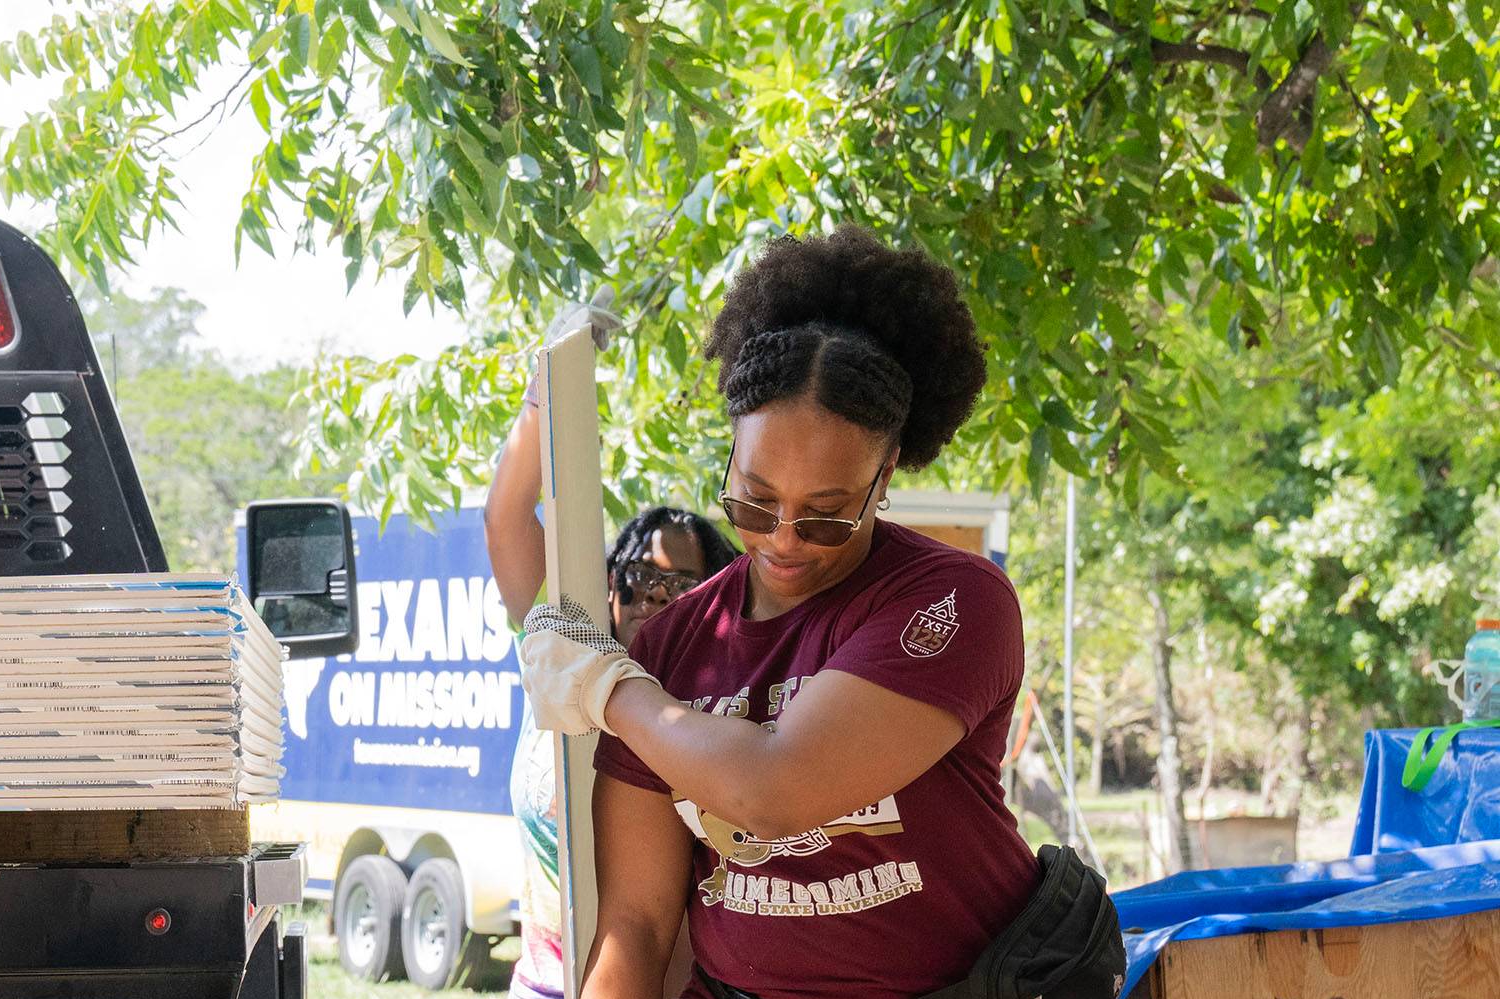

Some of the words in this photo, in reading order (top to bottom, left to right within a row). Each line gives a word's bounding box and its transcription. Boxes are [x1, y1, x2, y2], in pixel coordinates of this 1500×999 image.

[337, 577, 514, 664] EXANS
[908, 626, 946, 650] 125
[329, 671, 376, 727] ON
[377, 671, 513, 730] MISSION
[723, 898, 756, 915] TEXAS
[758, 902, 815, 916] STATE
[816, 881, 924, 916] UNIVERSITY
